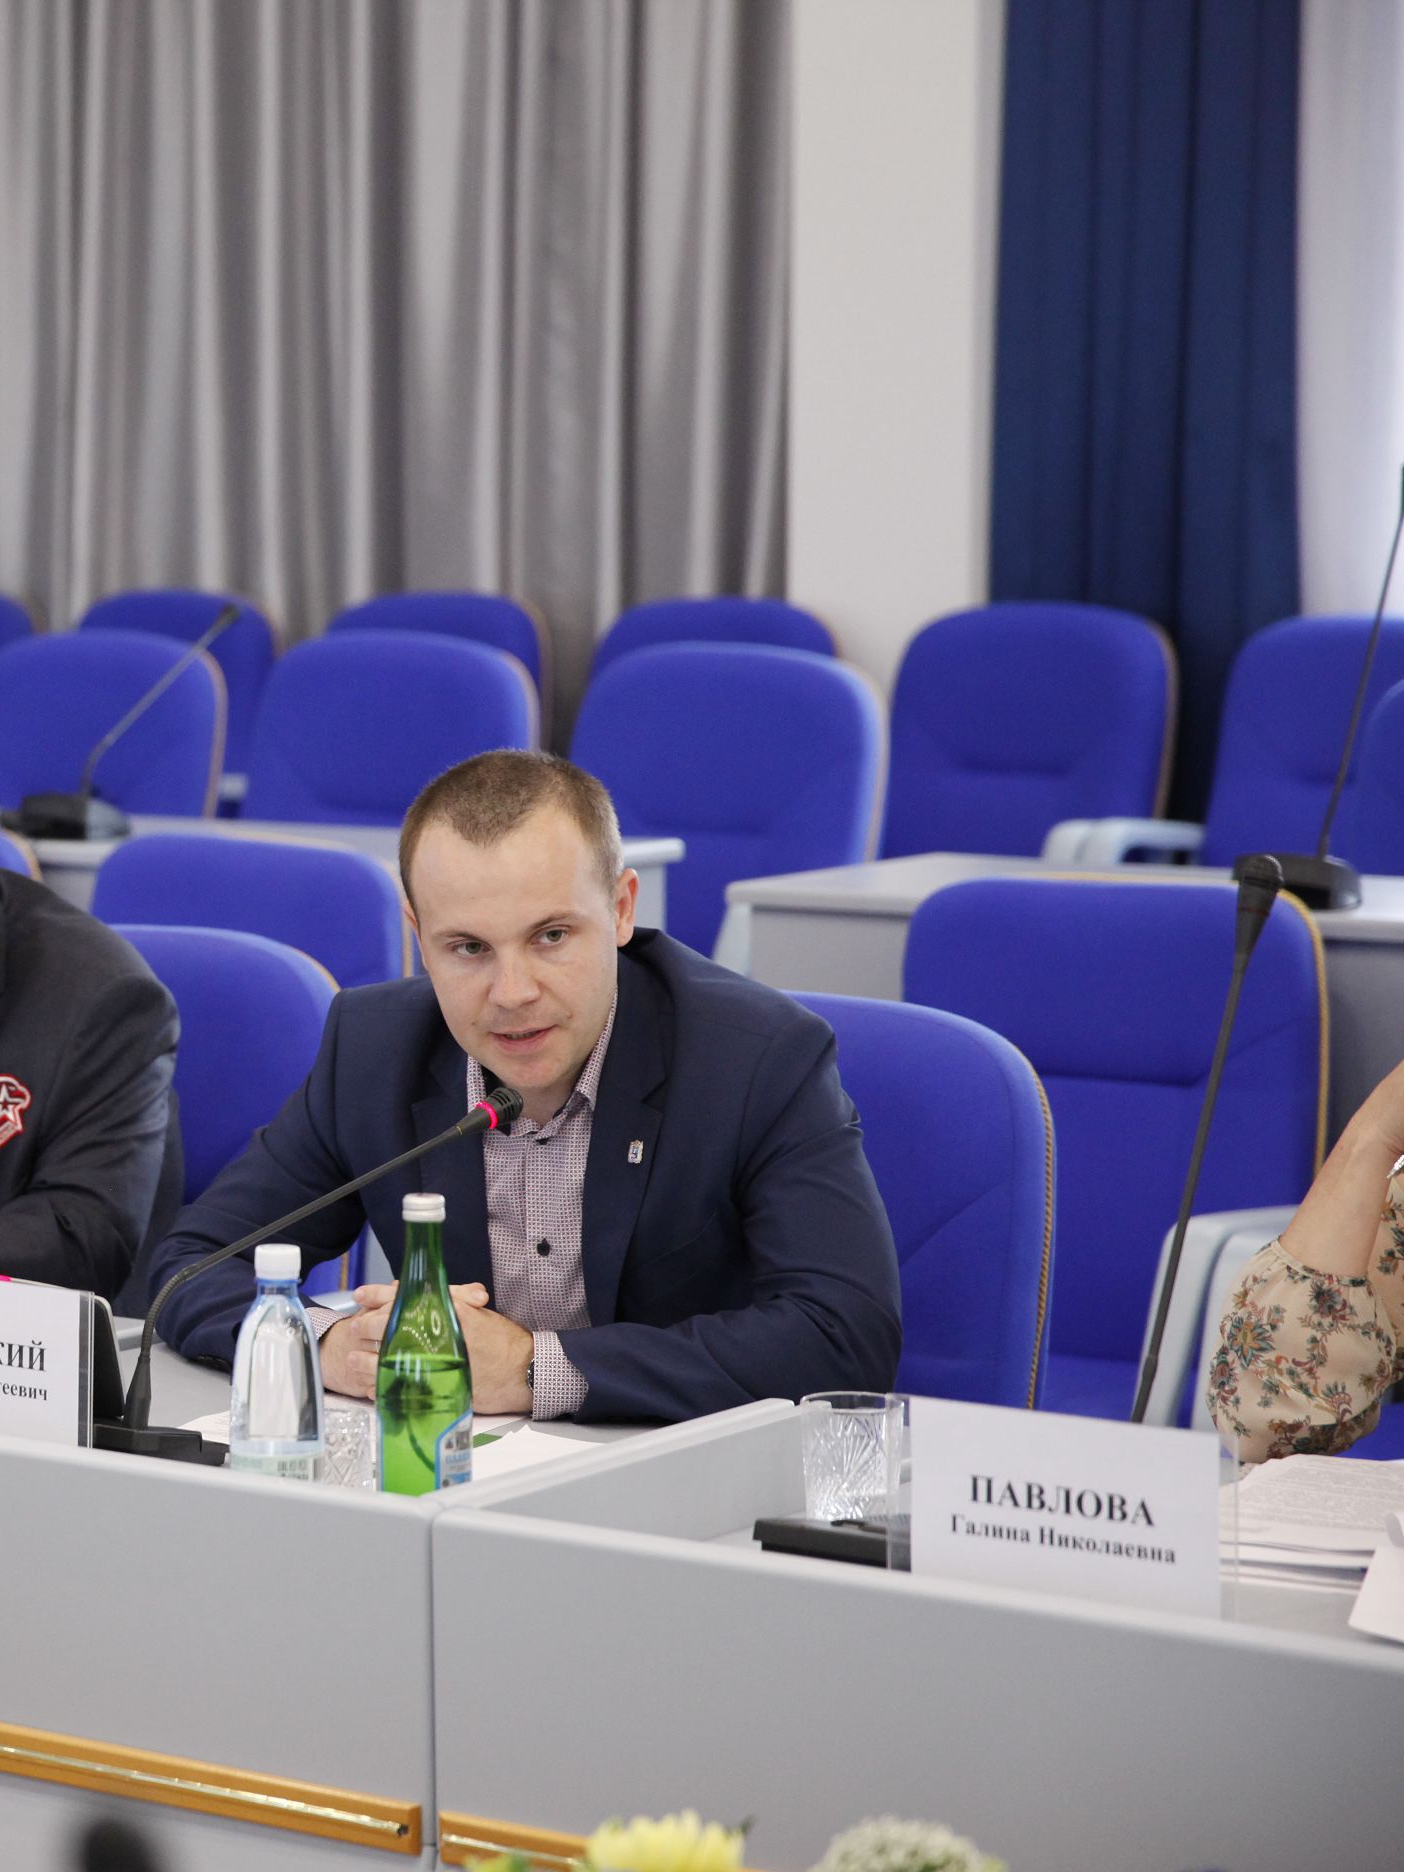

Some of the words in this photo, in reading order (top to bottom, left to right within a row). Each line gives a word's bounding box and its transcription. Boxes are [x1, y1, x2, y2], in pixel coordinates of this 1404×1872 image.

[970, 1474, 1155, 1527] ПАВЛОВА
[951, 1513, 1030, 1544] Галина
[1039, 1526, 1176, 1564] Николаевна
